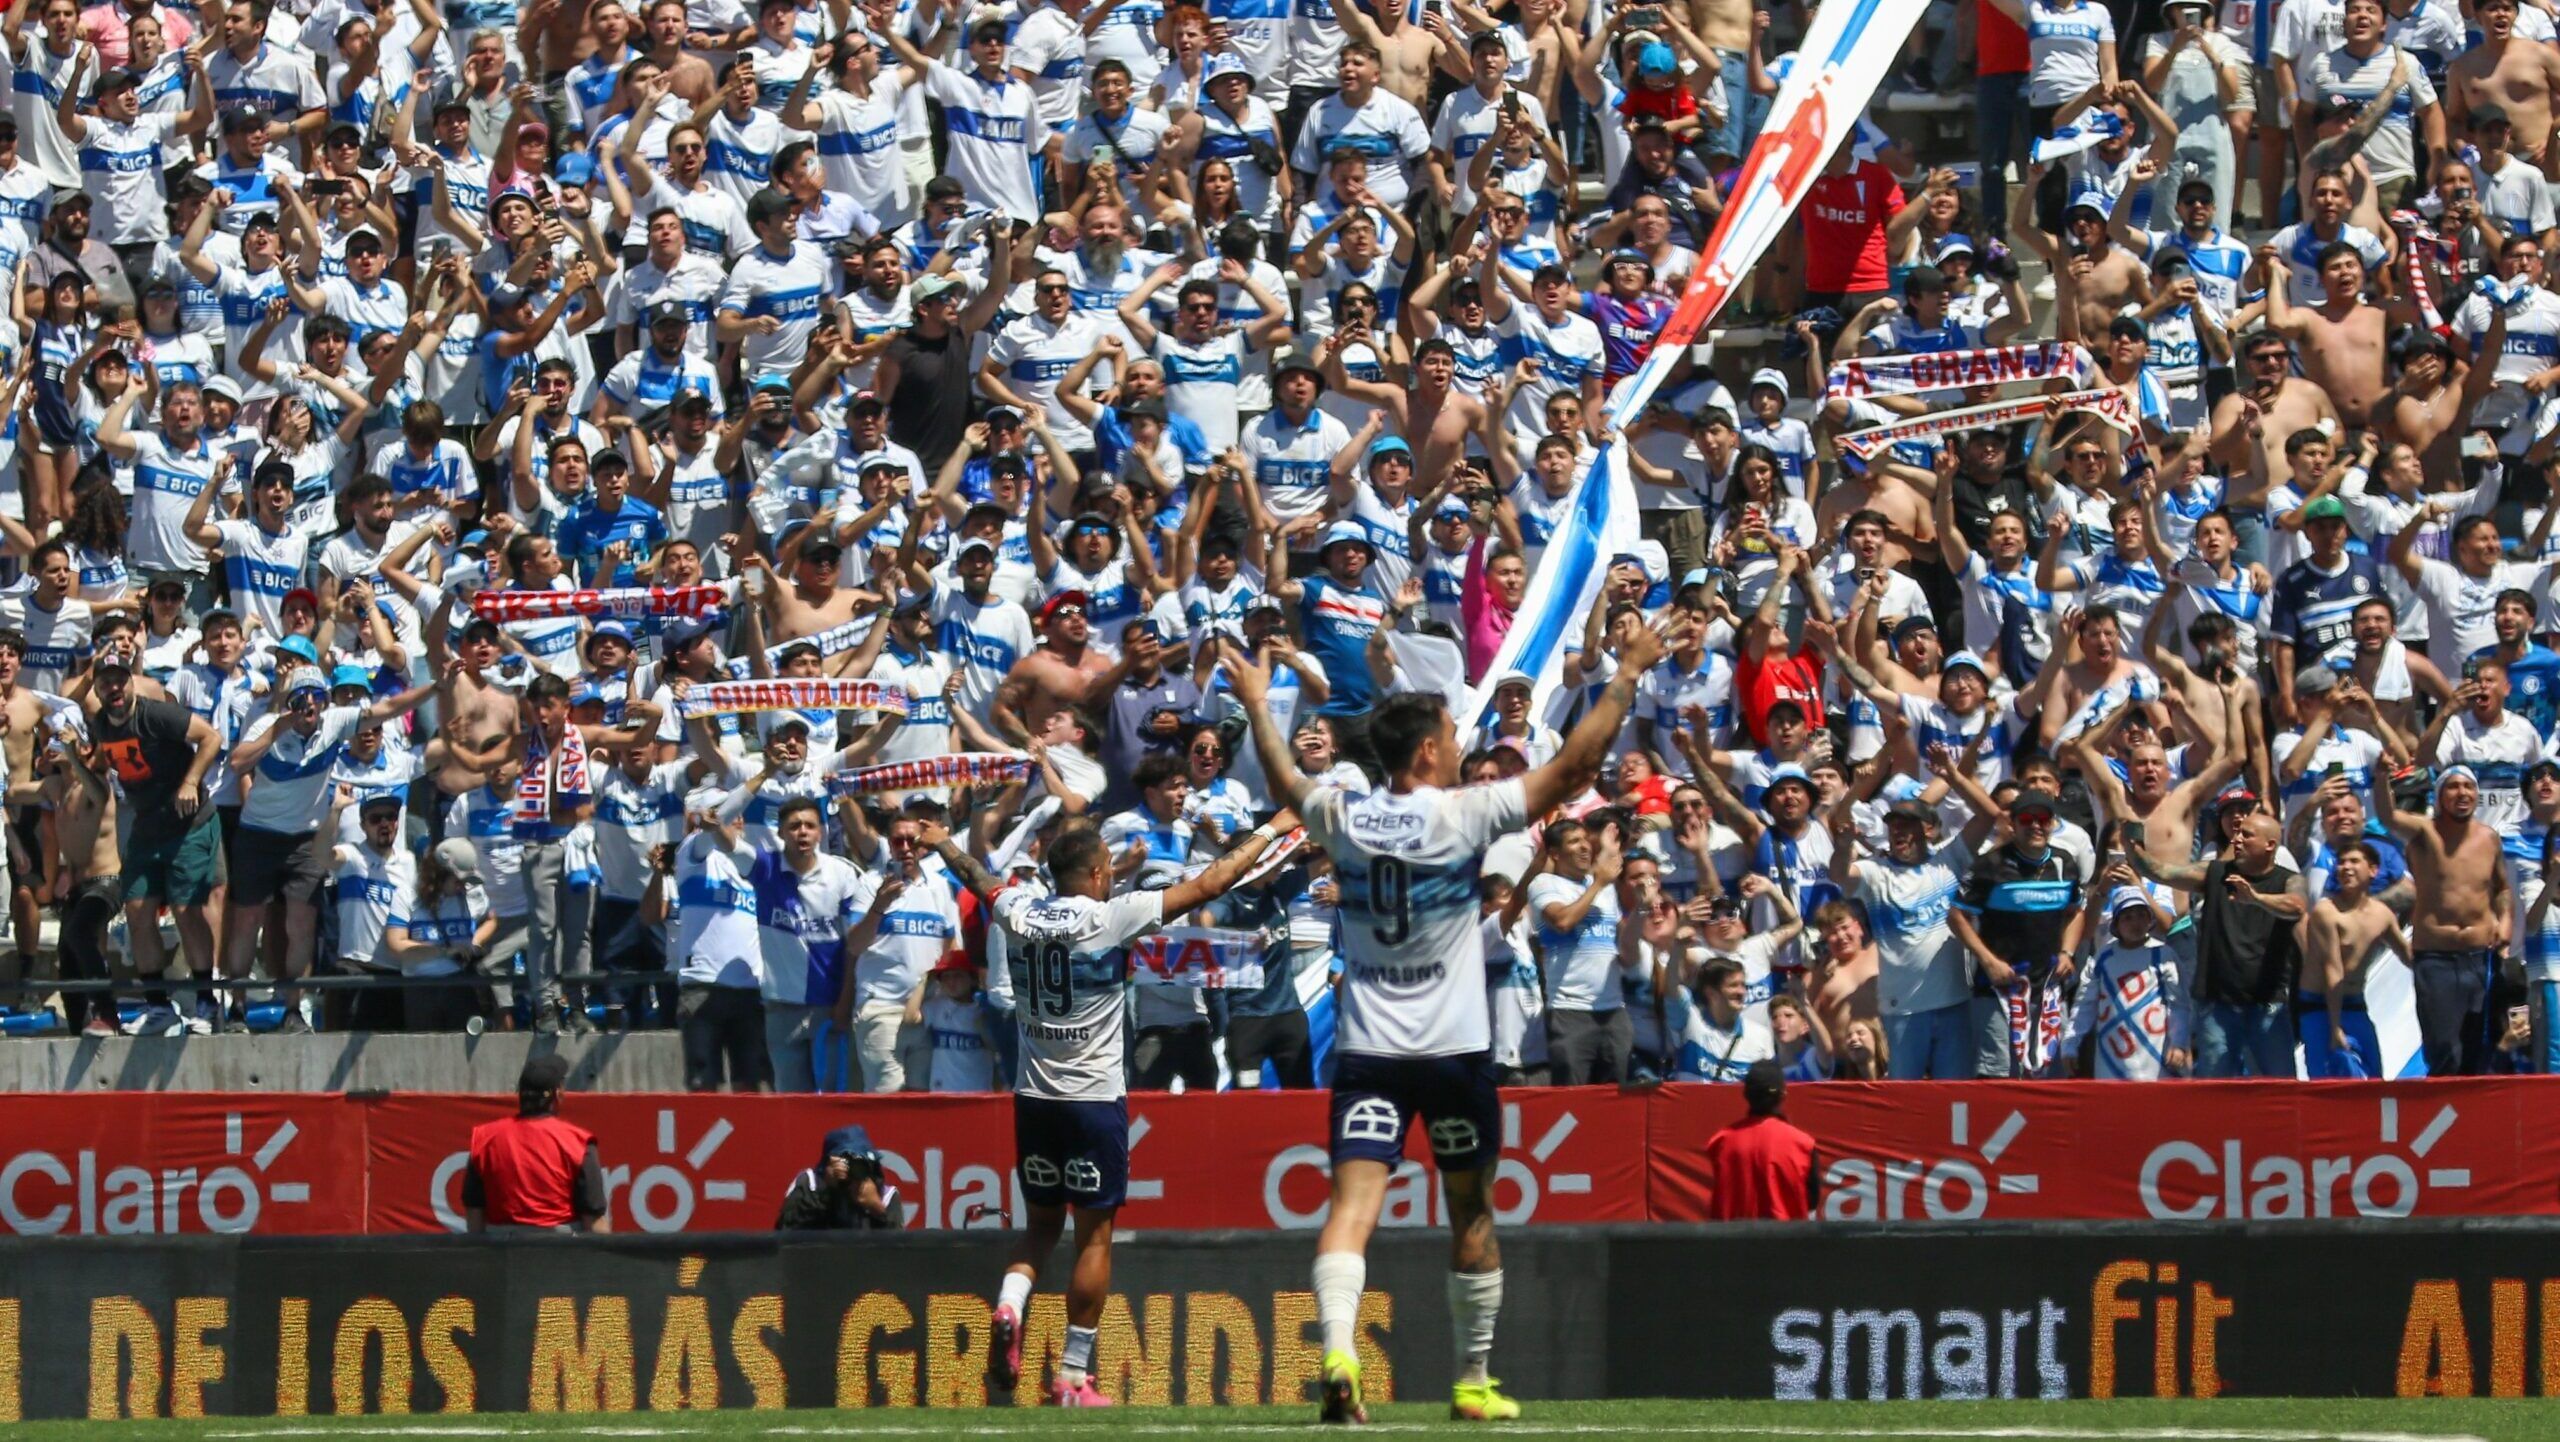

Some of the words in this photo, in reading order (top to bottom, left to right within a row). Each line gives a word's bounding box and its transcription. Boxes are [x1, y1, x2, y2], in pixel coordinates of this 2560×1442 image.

[2053, 22, 2090, 37] BICE
[1827, 205, 1866, 224] BICE
[187, 289, 219, 304] BIC
[1911, 341, 2077, 389] GRANJA
[171, 475, 205, 496] BIC
[1281, 464, 1322, 486] BICE
[686, 484, 724, 501] BICE
[265, 571, 294, 590] BIC
[711, 682, 833, 711] CUARTA
[838, 681, 880, 708] UC
[1353, 812, 1425, 830] CHERY
[1369, 853, 1410, 946] 9
[908, 920, 945, 935] BICE
[1026, 908, 1082, 922] CHERY
[427, 922, 466, 940] BCE
[1022, 942, 1073, 1017] 19
[2, 1148, 260, 1235] Claro
[432, 1149, 694, 1234] Cro
[880, 1148, 1028, 1230] Clar
[1264, 1144, 1540, 1229] Cao
[1824, 1157, 1988, 1223] aro
[2139, 1139, 2418, 1221] Claro
[89, 1295, 229, 1419] DE
[530, 1254, 789, 1414] MÁS
[1770, 1297, 2069, 1401] smart
[2090, 1259, 2235, 1400] fit
